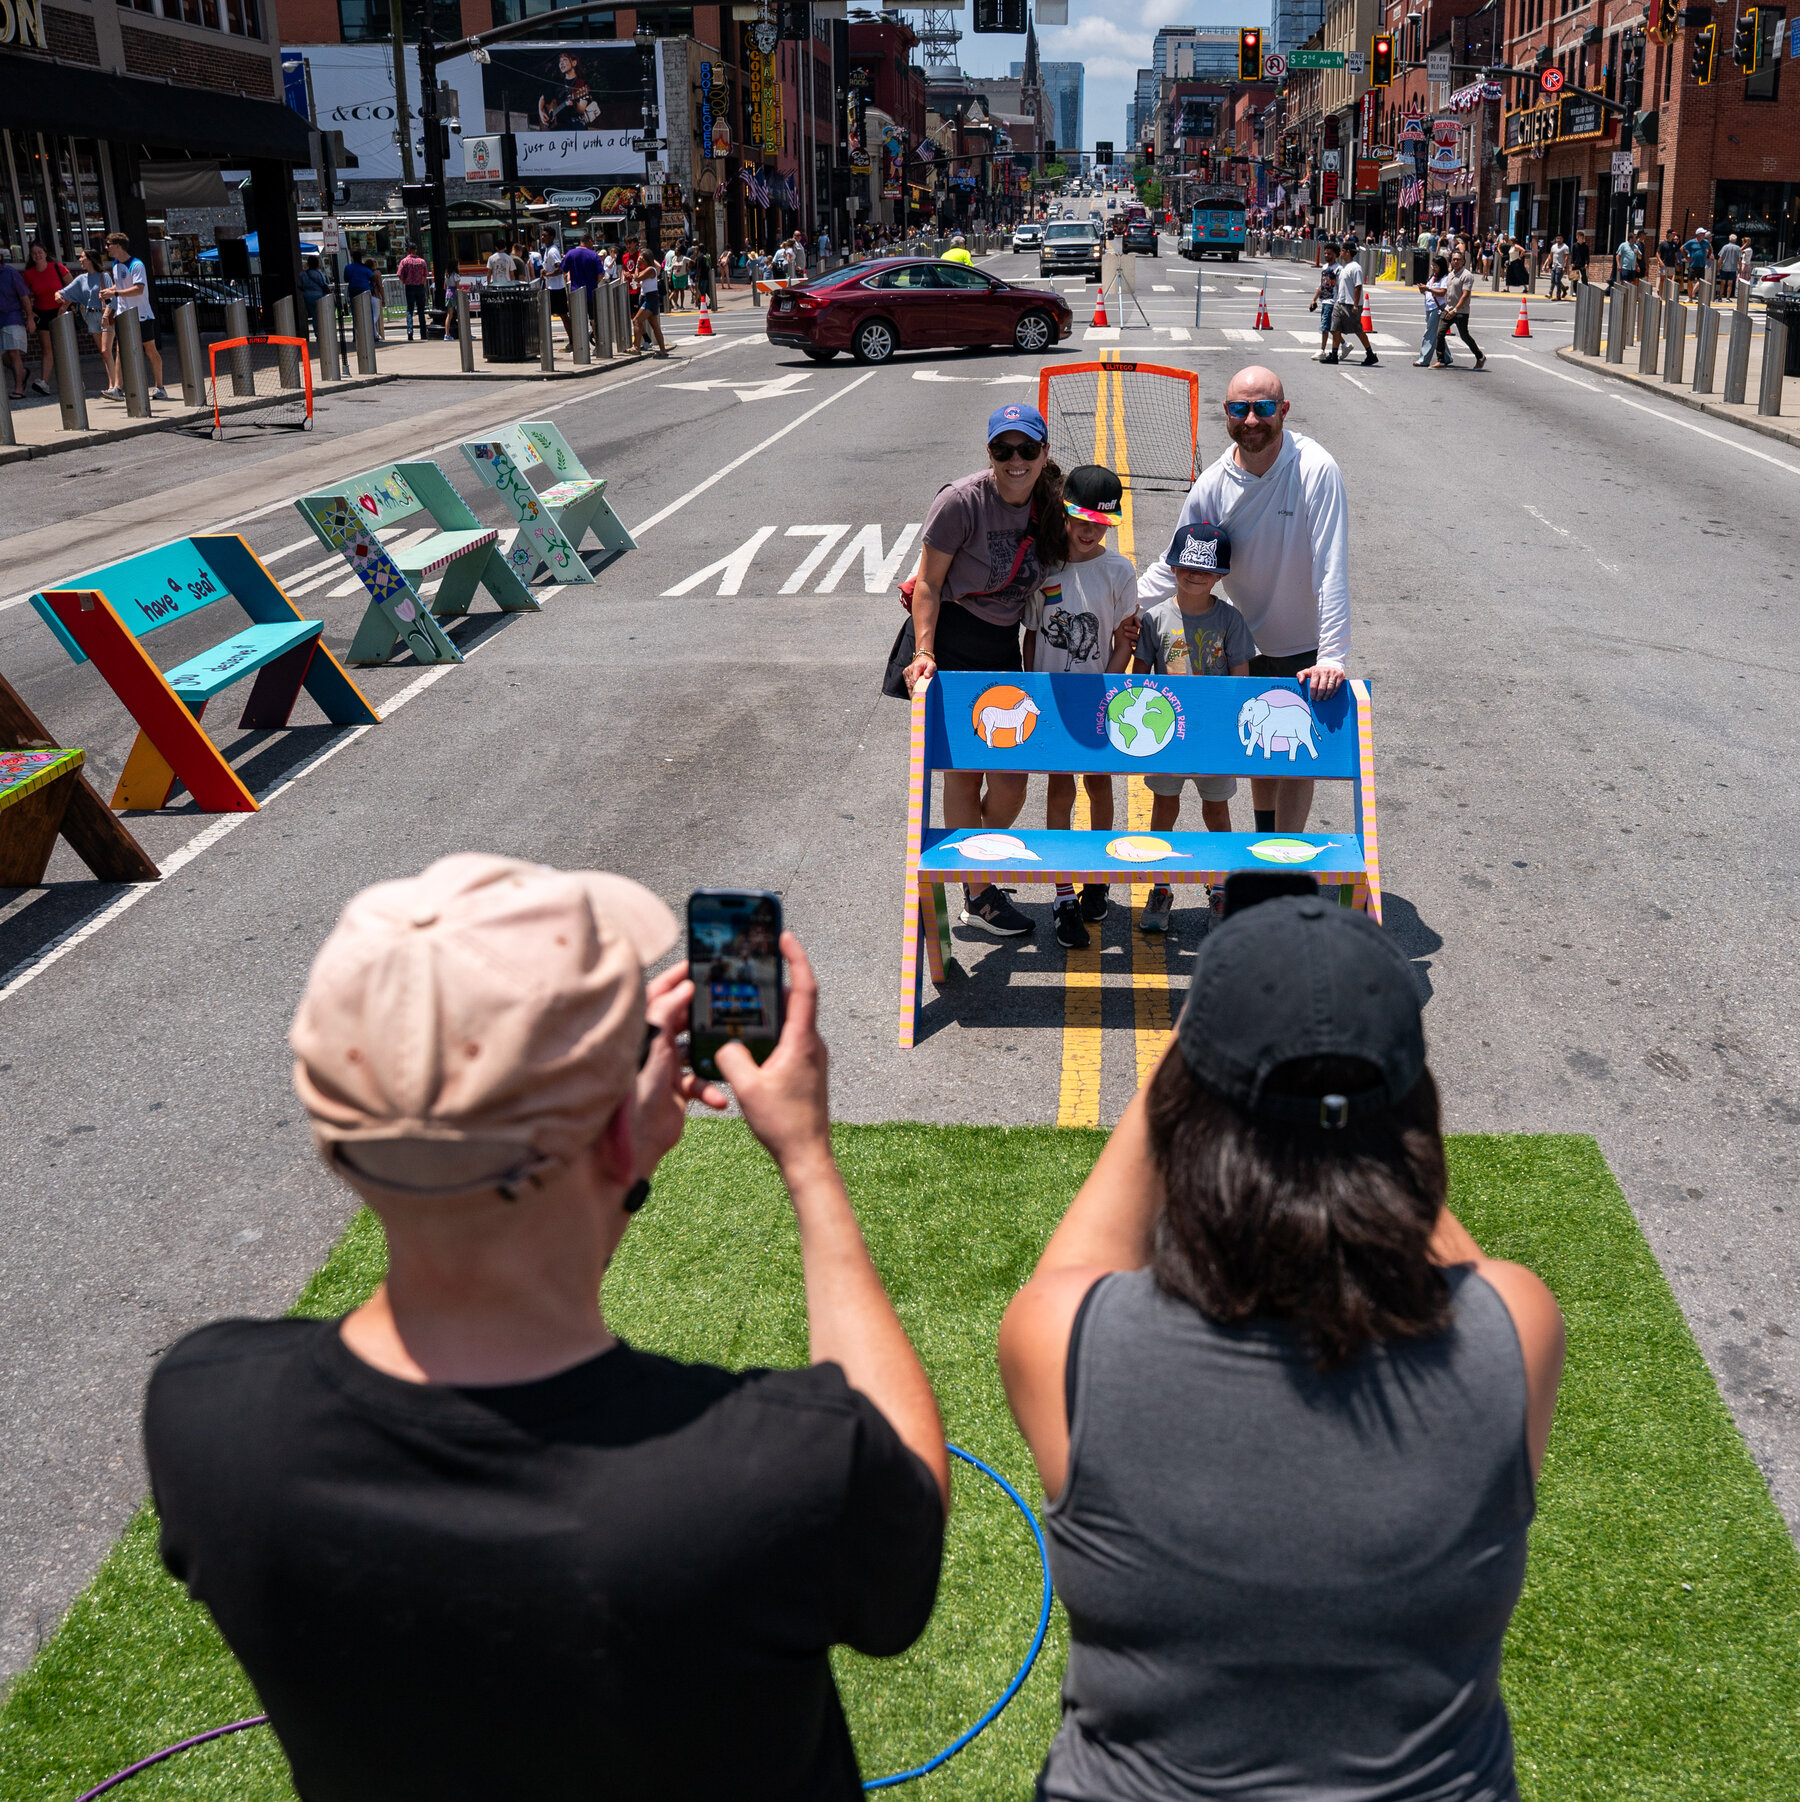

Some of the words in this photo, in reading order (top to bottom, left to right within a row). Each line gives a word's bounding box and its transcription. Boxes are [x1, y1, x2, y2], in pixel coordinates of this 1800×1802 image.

[1290, 54, 1296, 64] S
[1302, 54, 1316, 64] 2nd
[1336, 55, 1343, 64] N
[701, 62, 712, 158] BOOTLEGGERS
[750, 50, 762, 144] GOODNIGHT
[763, 54, 775, 152] NASHVILLE
[523, 143, 545, 161] just
[550, 141, 555, 150] a
[561, 132, 578, 158] girl
[583, 135, 603, 150] with
[607, 138, 615, 147] a
[1517, 107, 1555, 144] CHIEF'S
[1613, 163, 1622, 172] OK
[1097, 499, 1118, 510] neff
[659, 524, 922, 597] NLY
[134, 594, 179, 622] have
[167, 578, 182, 592] a
[187, 568, 217, 600] seat
[1096, 687, 1119, 735] MIGRATION
[1124, 679, 1133, 688] IS
[1143, 679, 1158, 689] AN
[1161, 686, 1184, 713] EARTH
[1176, 715, 1186, 740] RIGHT
